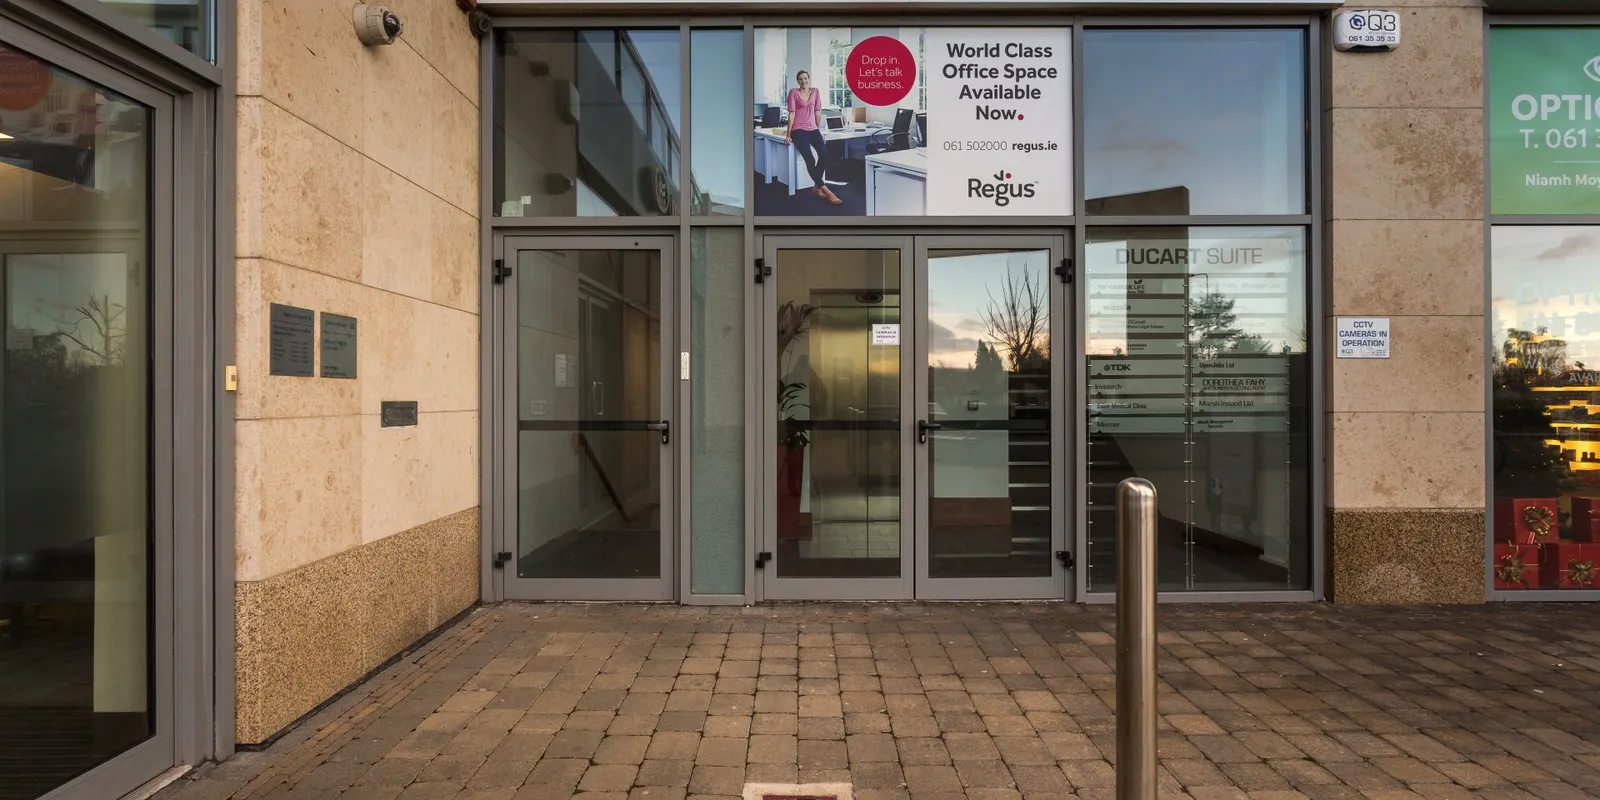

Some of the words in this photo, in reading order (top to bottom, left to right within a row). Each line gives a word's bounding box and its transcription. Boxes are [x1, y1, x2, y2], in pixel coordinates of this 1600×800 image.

[1368, 14, 1396, 31] Q3
[946, 43, 1000, 58] World
[1005, 43, 1053, 58] Class
[861, 55, 887, 66] Drop
[889, 54, 900, 65] in.
[859, 67, 883, 77] Let's
[885, 67, 903, 77] talk
[942, 63, 999, 79] Office
[1003, 63, 1058, 82] Space
[857, 79, 904, 89] business.
[959, 84, 1042, 100] Available
[1511, 93, 1600, 121] OPTI
[1519, 128, 1539, 149] T.
[1545, 128, 1587, 149] 061
[943, 141, 963, 151] 061
[966, 141, 1008, 151] 502000
[1012, 140, 1058, 153] regus.ie
[1525, 173, 1571, 186] Niamh
[967, 178, 1036, 207] Regus
[1115, 248, 1203, 265] DUCART
[1207, 248, 1263, 265] SUITE
[1339, 330, 1377, 338] CAMERAS
[1379, 330, 1388, 338] IN
[1341, 339, 1385, 347] OPERATION
[1109, 363, 1132, 371] TDK
